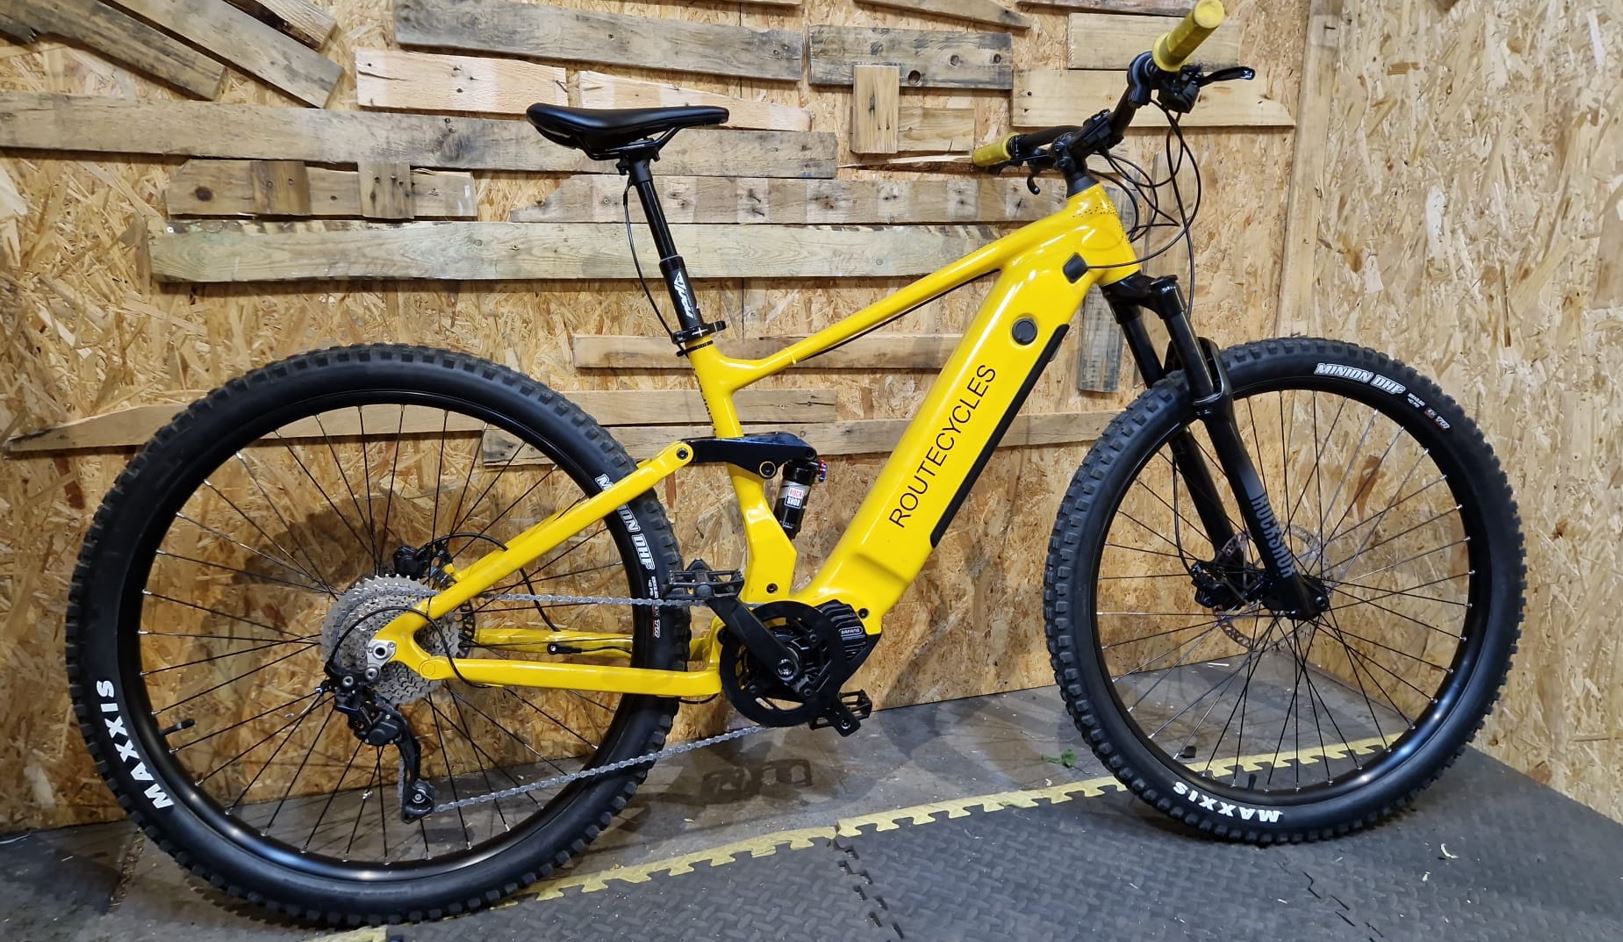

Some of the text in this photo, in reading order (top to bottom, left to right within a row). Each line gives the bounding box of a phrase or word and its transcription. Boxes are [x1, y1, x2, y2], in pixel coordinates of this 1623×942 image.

[1314, 363, 1406, 395] MINION DHF
[889, 365, 996, 528] ROUTECYCLES
[631, 534, 656, 572] DHF
[96, 680, 175, 809] MAXXIS
[1173, 782, 1283, 822] MAXXIS
